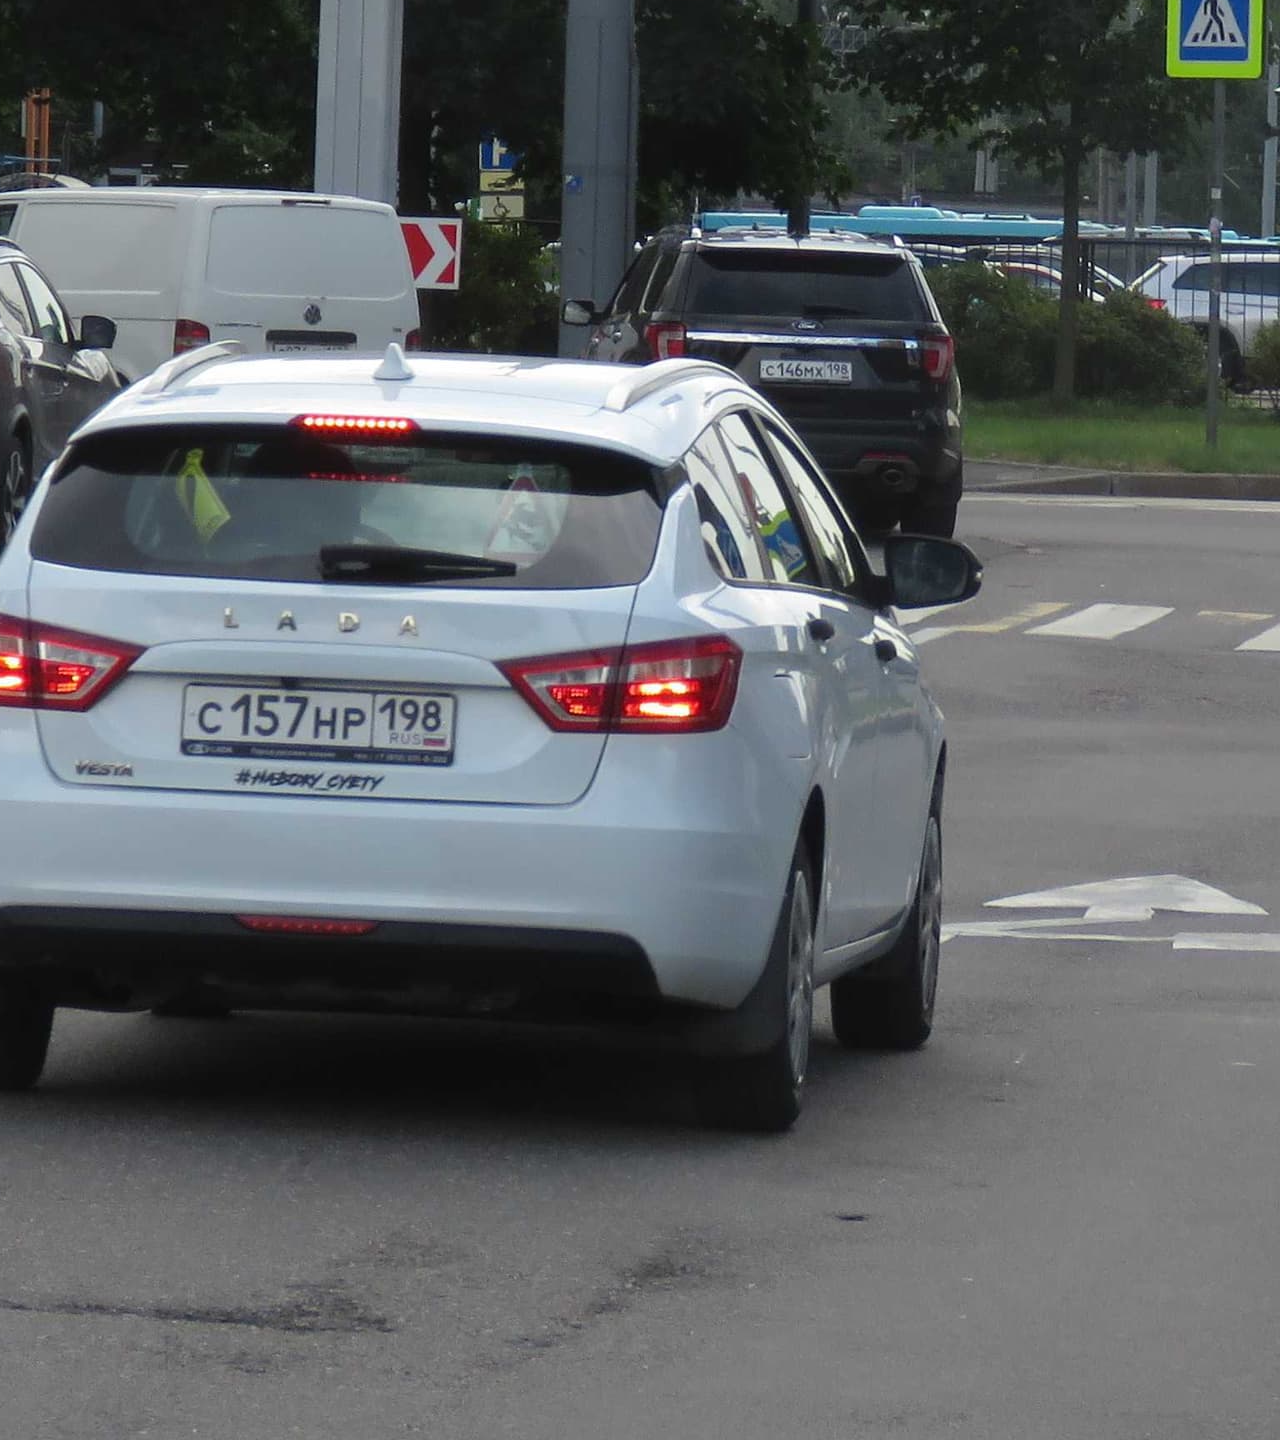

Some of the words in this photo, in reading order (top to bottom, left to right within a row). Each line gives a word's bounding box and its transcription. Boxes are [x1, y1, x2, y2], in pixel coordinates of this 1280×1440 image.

[766, 361, 823, 378] С146МХ
[827, 363, 849, 377] 198
[224, 607, 418, 637] LADA
[198, 693, 366, 740] С157НР
[378, 698, 442, 732] 198
[389, 733, 420, 745] RUS
[75, 760, 133, 777] VESTA
